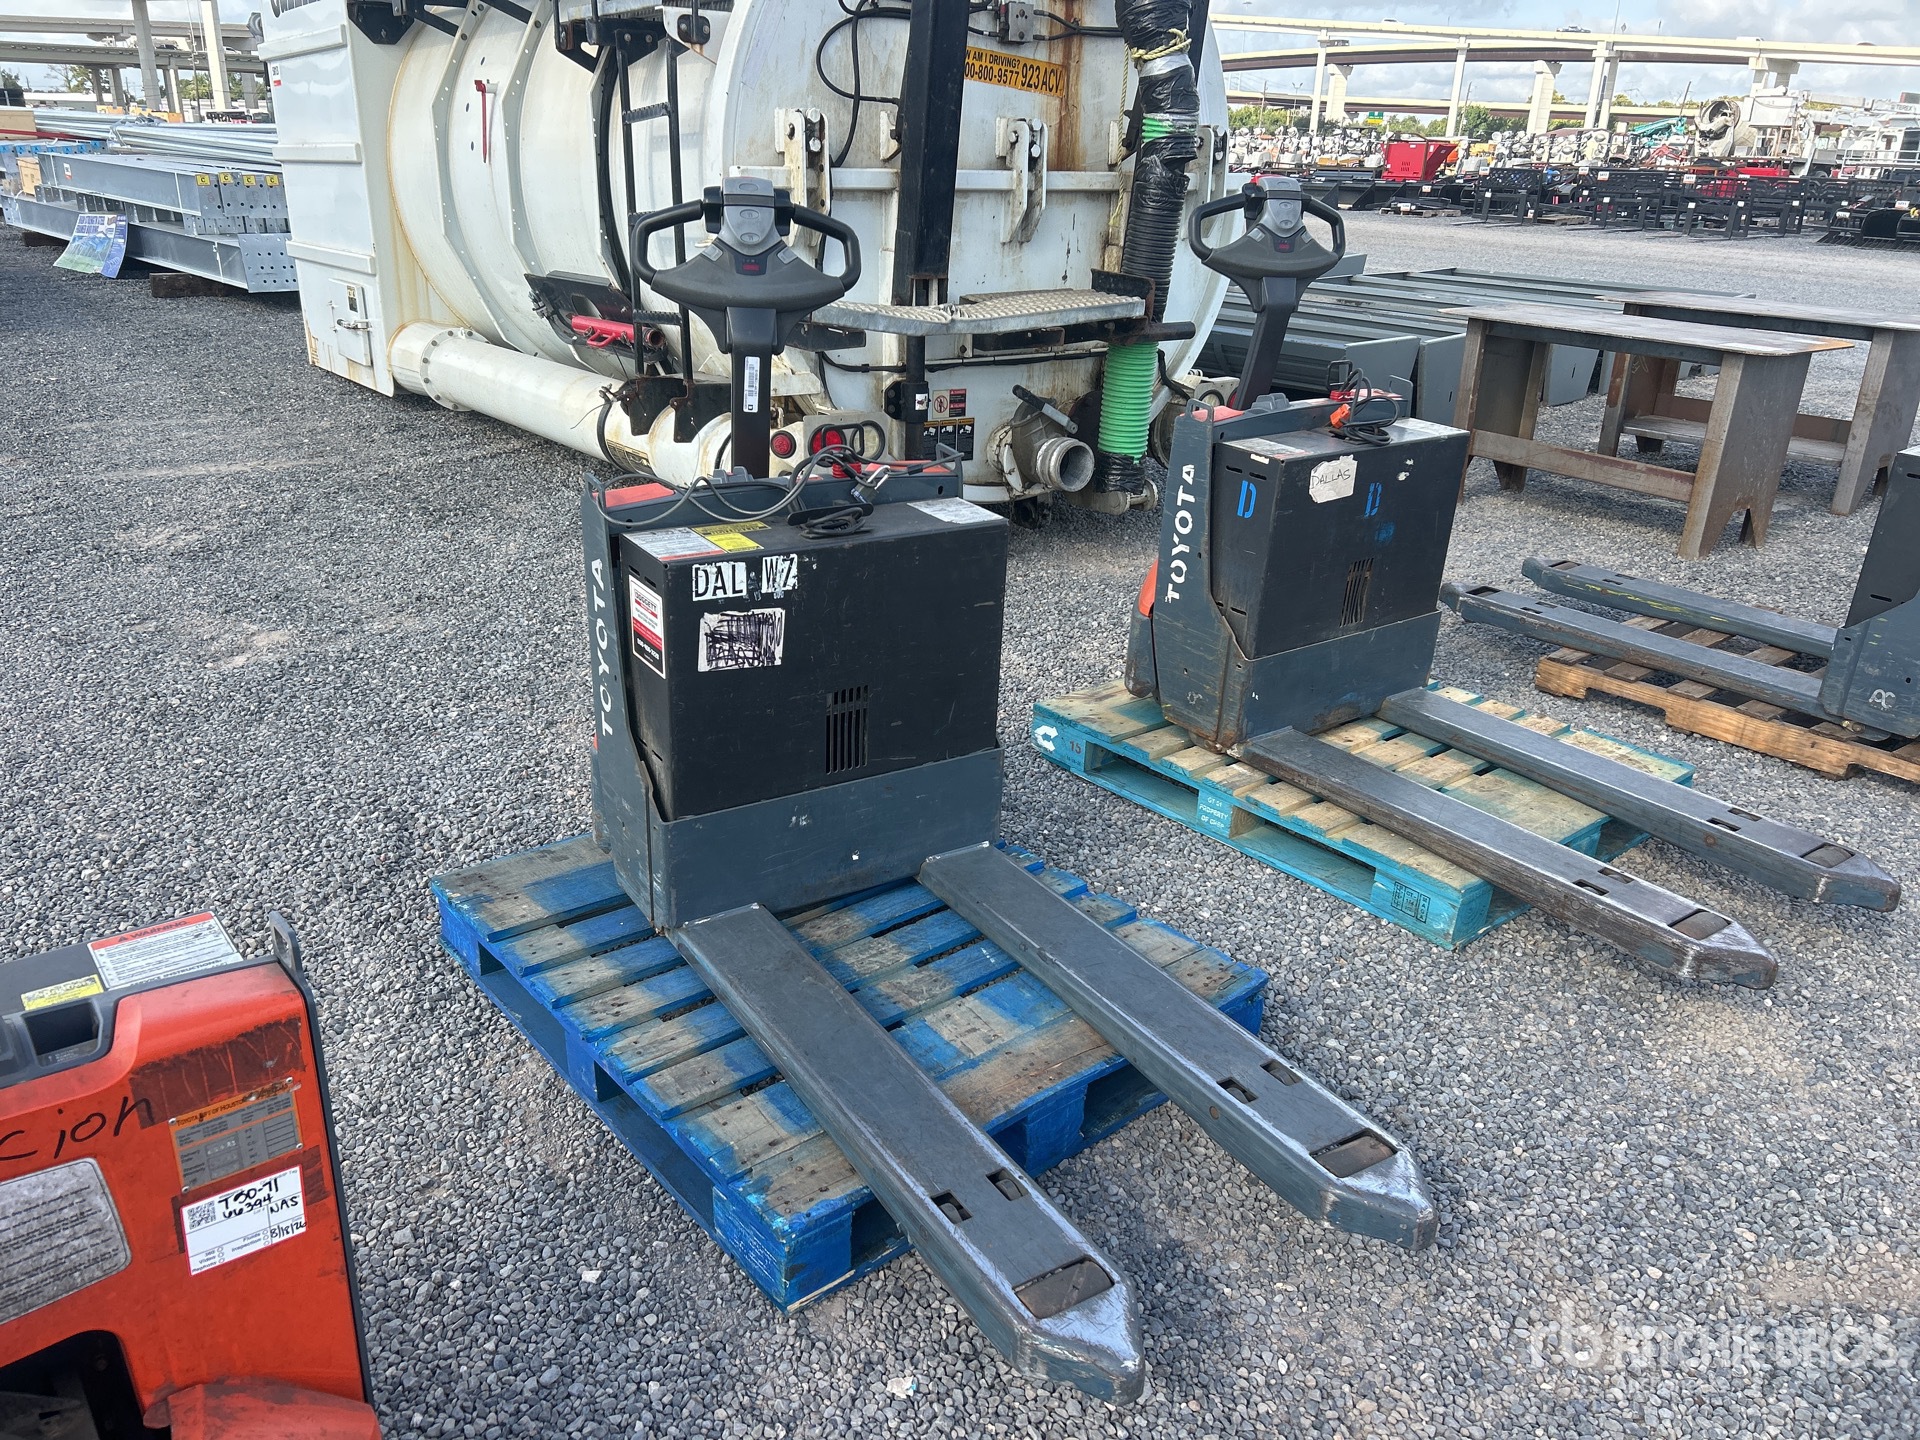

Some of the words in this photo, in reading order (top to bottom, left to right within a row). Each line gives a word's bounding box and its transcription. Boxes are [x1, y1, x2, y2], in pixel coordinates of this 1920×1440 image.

[972, 52, 983, 62] AM
[984, 53, 988, 62] I
[989, 54, 1020, 69] DRIVING?
[1021, 63, 1041, 90] 923
[1041, 68, 1062, 94] ACV
[1311, 468, 1352, 490] DALLAS
[1236, 480, 1257, 518] D
[1364, 482, 1382, 518] D
[1164, 464, 1196, 603] TOYOTA
[694, 562, 744, 598] DAL
[590, 557, 613, 737] TOYOTA
[1199, 804, 1228, 820] PROPERTY
[131, 920, 189, 939] WARNING
[269, 1196, 299, 1214] NAS
